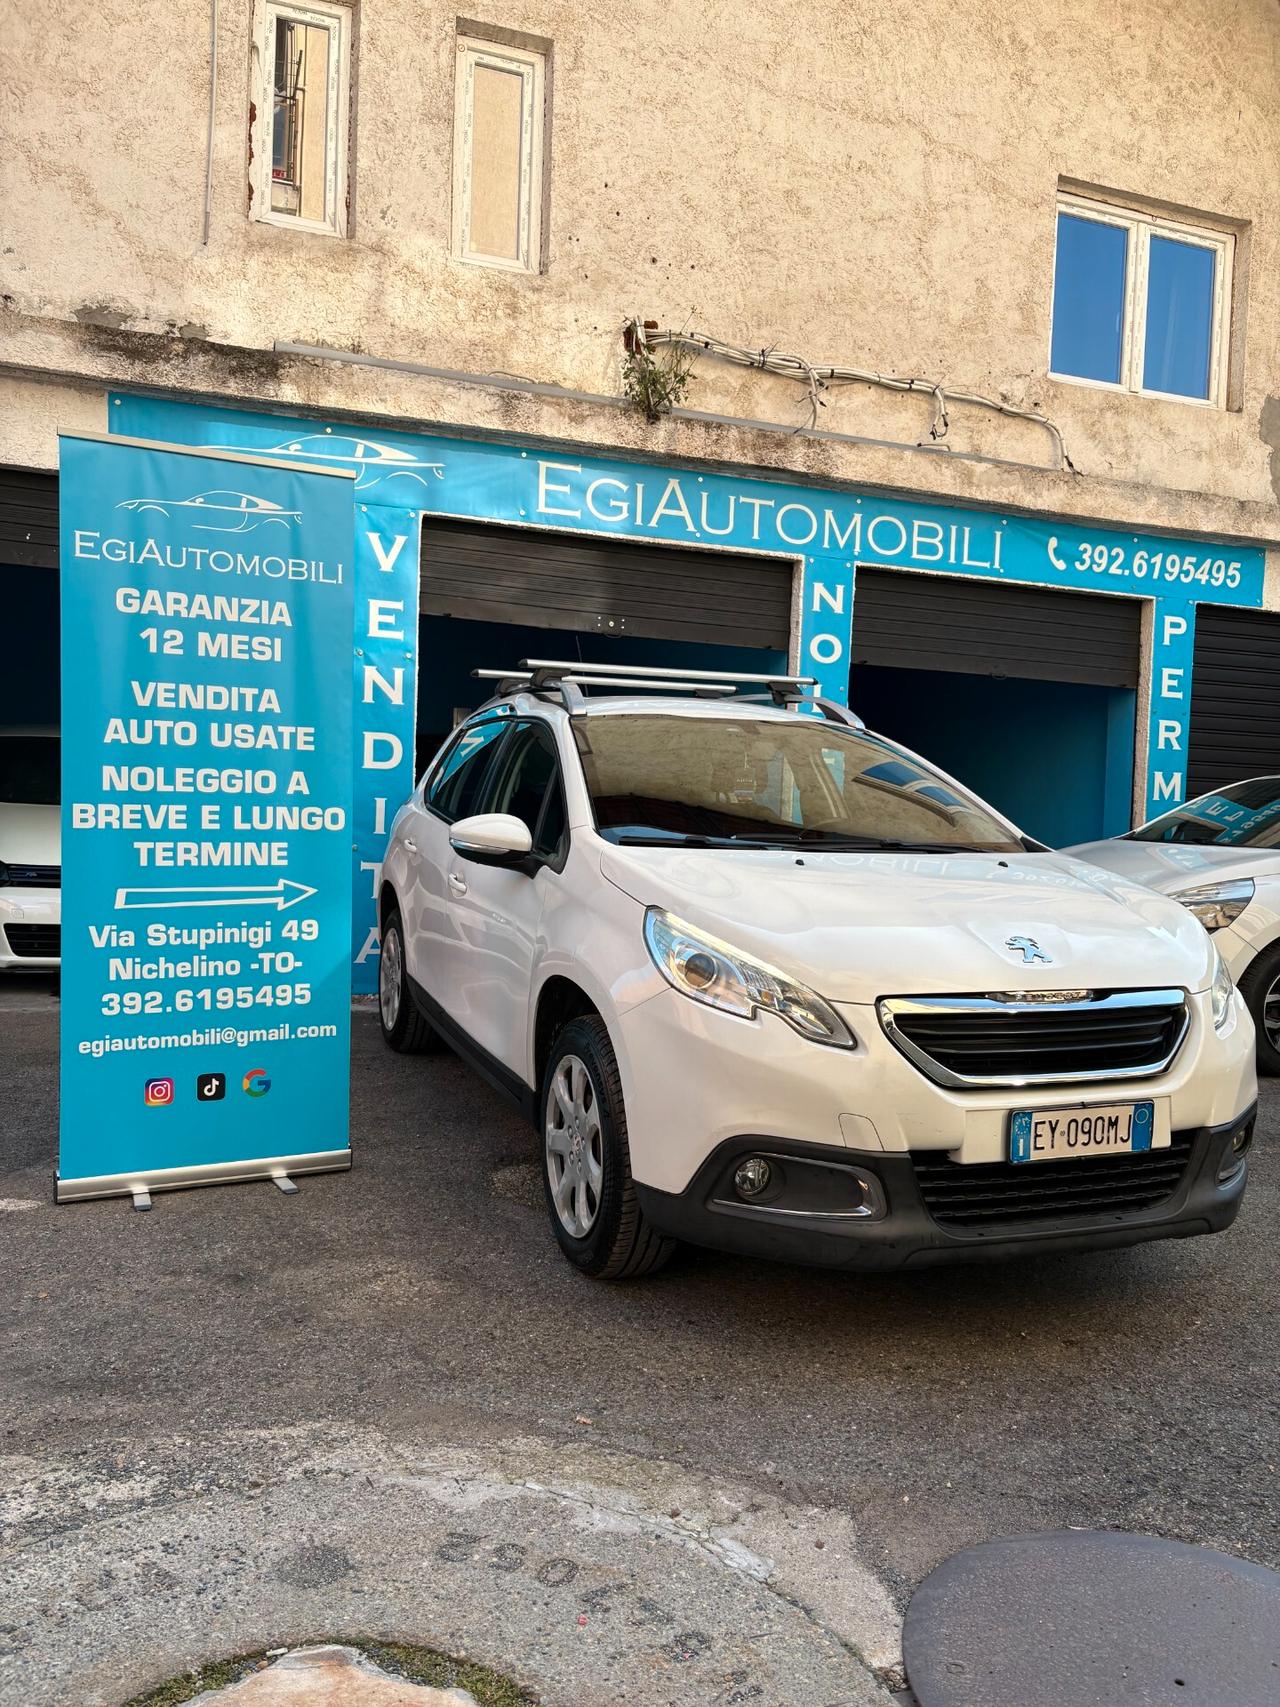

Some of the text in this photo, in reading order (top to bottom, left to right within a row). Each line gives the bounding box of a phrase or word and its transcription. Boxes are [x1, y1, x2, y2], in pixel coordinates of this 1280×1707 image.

[1075, 542, 1242, 589] 392.6195495
[115, 587, 293, 627] GARANZIA
[139, 627, 282, 663] 12 MESI
[131, 680, 281, 714] VENDITA
[103, 717, 315, 751] AUTO USATE
[102, 765, 310, 795] NOLEGGIO A
[72, 803, 346, 831] BREVE E LUNGO
[133, 841, 289, 867] TERMINE
[88, 919, 319, 950] Via Stupinigi 49
[109, 951, 303, 981] Nichelino -TO-
[101, 983, 311, 1016] 392.6195495
[78, 1023, 337, 1058] egiautomobili@gmail.com
